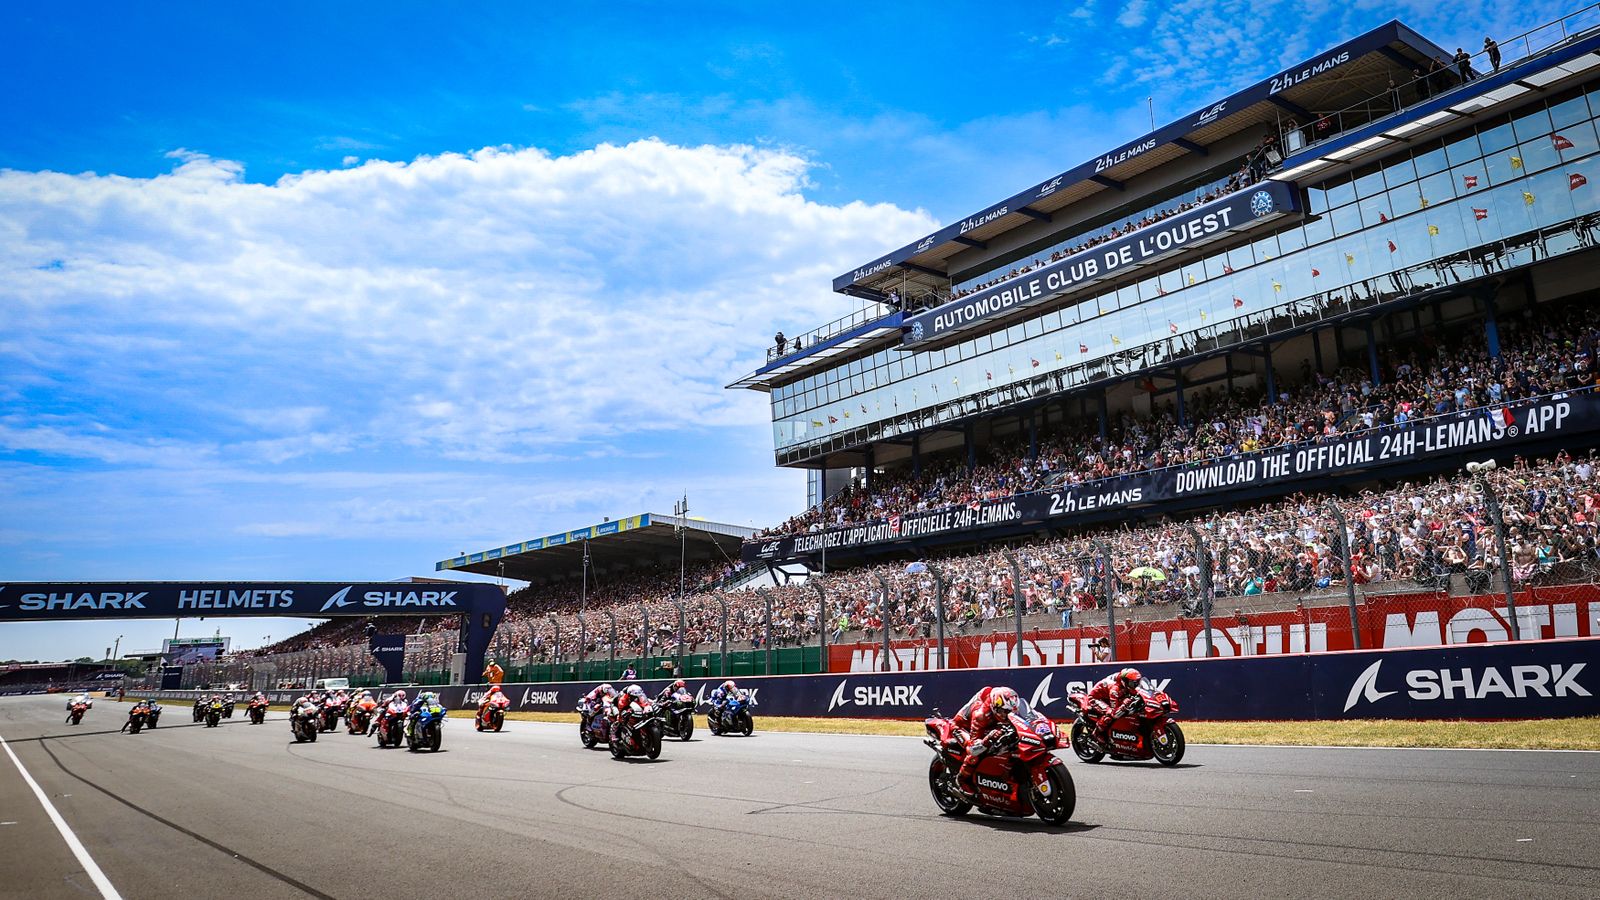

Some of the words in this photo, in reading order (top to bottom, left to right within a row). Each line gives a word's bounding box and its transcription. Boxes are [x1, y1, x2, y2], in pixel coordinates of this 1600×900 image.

[1295, 69, 1310, 83] LE
[1312, 51, 1350, 76] MANS
[1114, 151, 1126, 164] LE
[1127, 138, 1156, 158] MANS
[975, 216, 985, 227] LE
[985, 206, 1008, 222] MANS
[874, 259, 892, 273] MANS
[934, 279, 1042, 332] AUTOMOBILE
[1046, 258, 1099, 290] CLUB
[1104, 245, 1134, 270] DE
[1139, 206, 1232, 257] L'OUEST
[1175, 459, 1256, 493] DOWNLOAD
[1261, 453, 1291, 479] THE
[1295, 439, 1374, 474] OFFICIAL
[1524, 402, 1571, 435] APP
[1078, 496, 1096, 511] LE
[1098, 488, 1142, 507] MANS
[901, 512, 952, 537] OFFICIELLE
[19, 592, 149, 610] SHARK
[177, 589, 294, 609] HELMETS
[363, 591, 458, 607] SHARK
[1405, 662, 1593, 700] SHARK
[531, 691, 559, 704] SHARK
[854, 685, 923, 706] SHARK
[1112, 731, 1137, 741] Lenovo
[977, 775, 1008, 791] Lenovo
